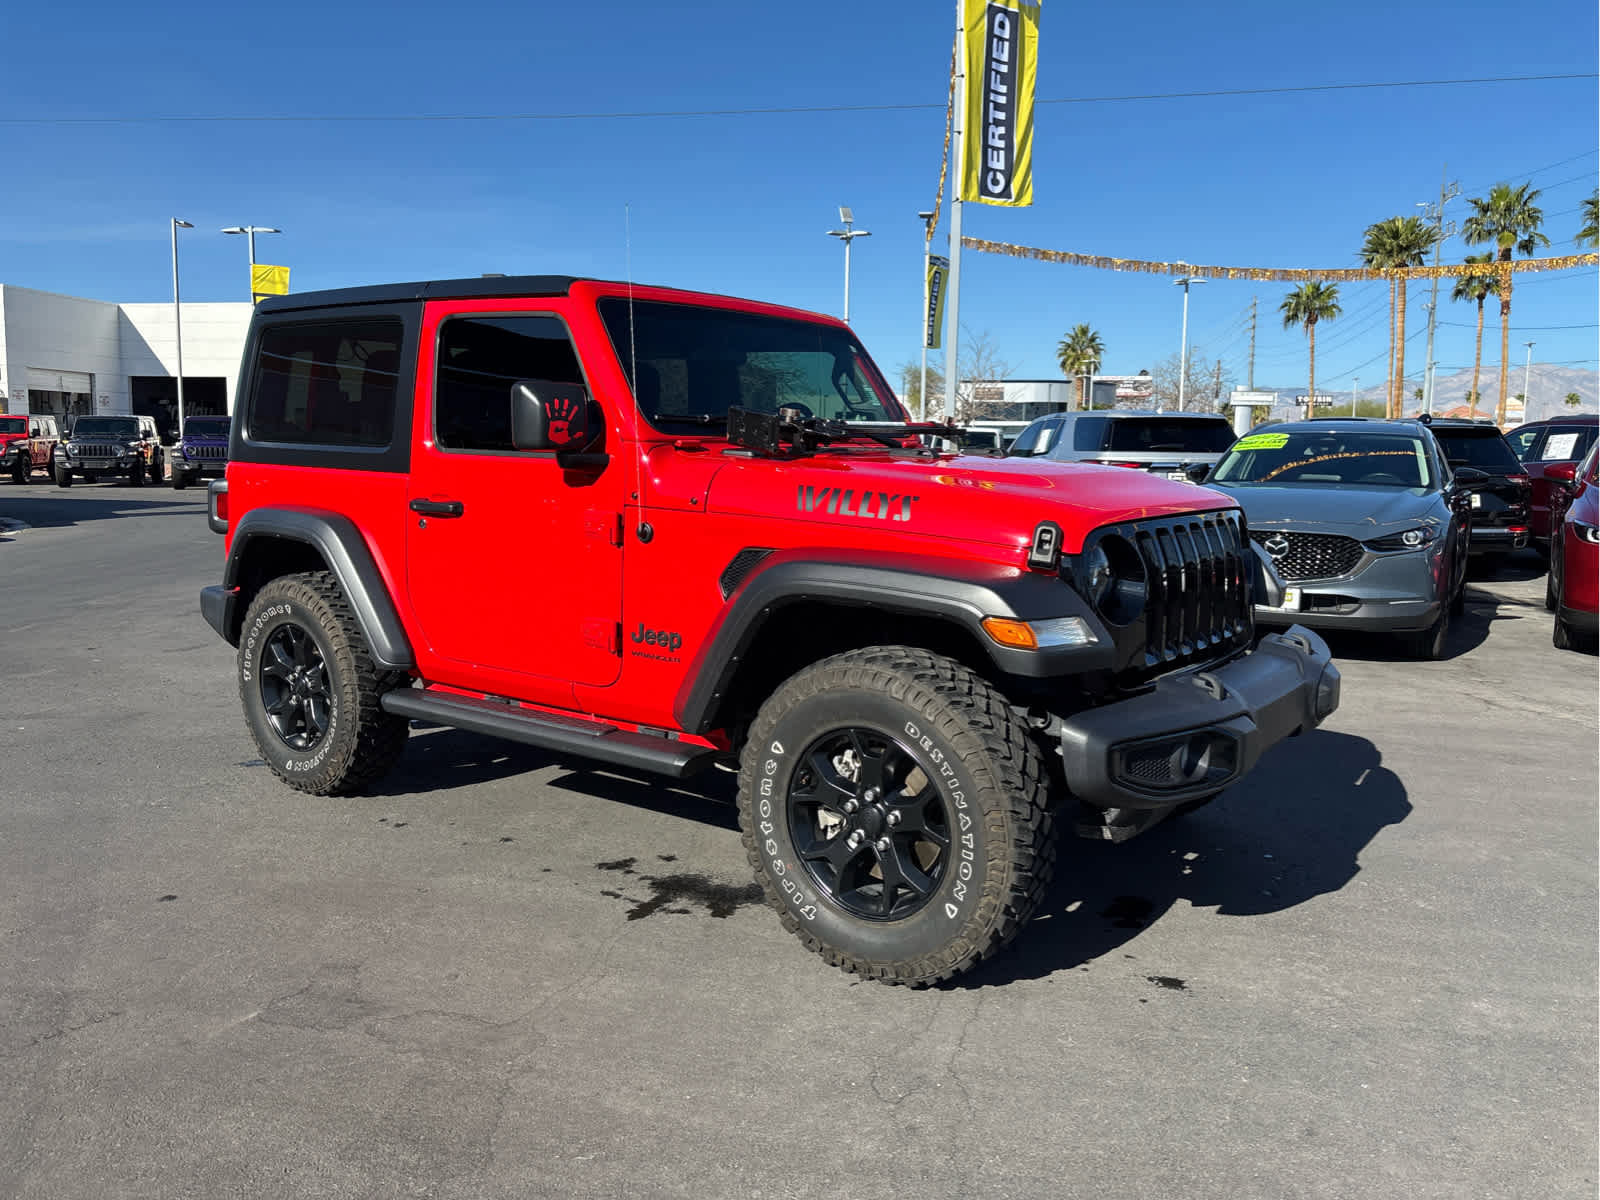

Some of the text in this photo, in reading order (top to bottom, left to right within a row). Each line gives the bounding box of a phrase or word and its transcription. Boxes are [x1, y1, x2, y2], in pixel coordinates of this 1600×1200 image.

[987, 12, 1011, 194] CERTIFIED
[797, 485, 920, 522] WILLYS
[631, 622, 682, 653] Jeep
[631, 650, 681, 664] WRANGLER
[904, 721, 974, 902] DESTINATION
